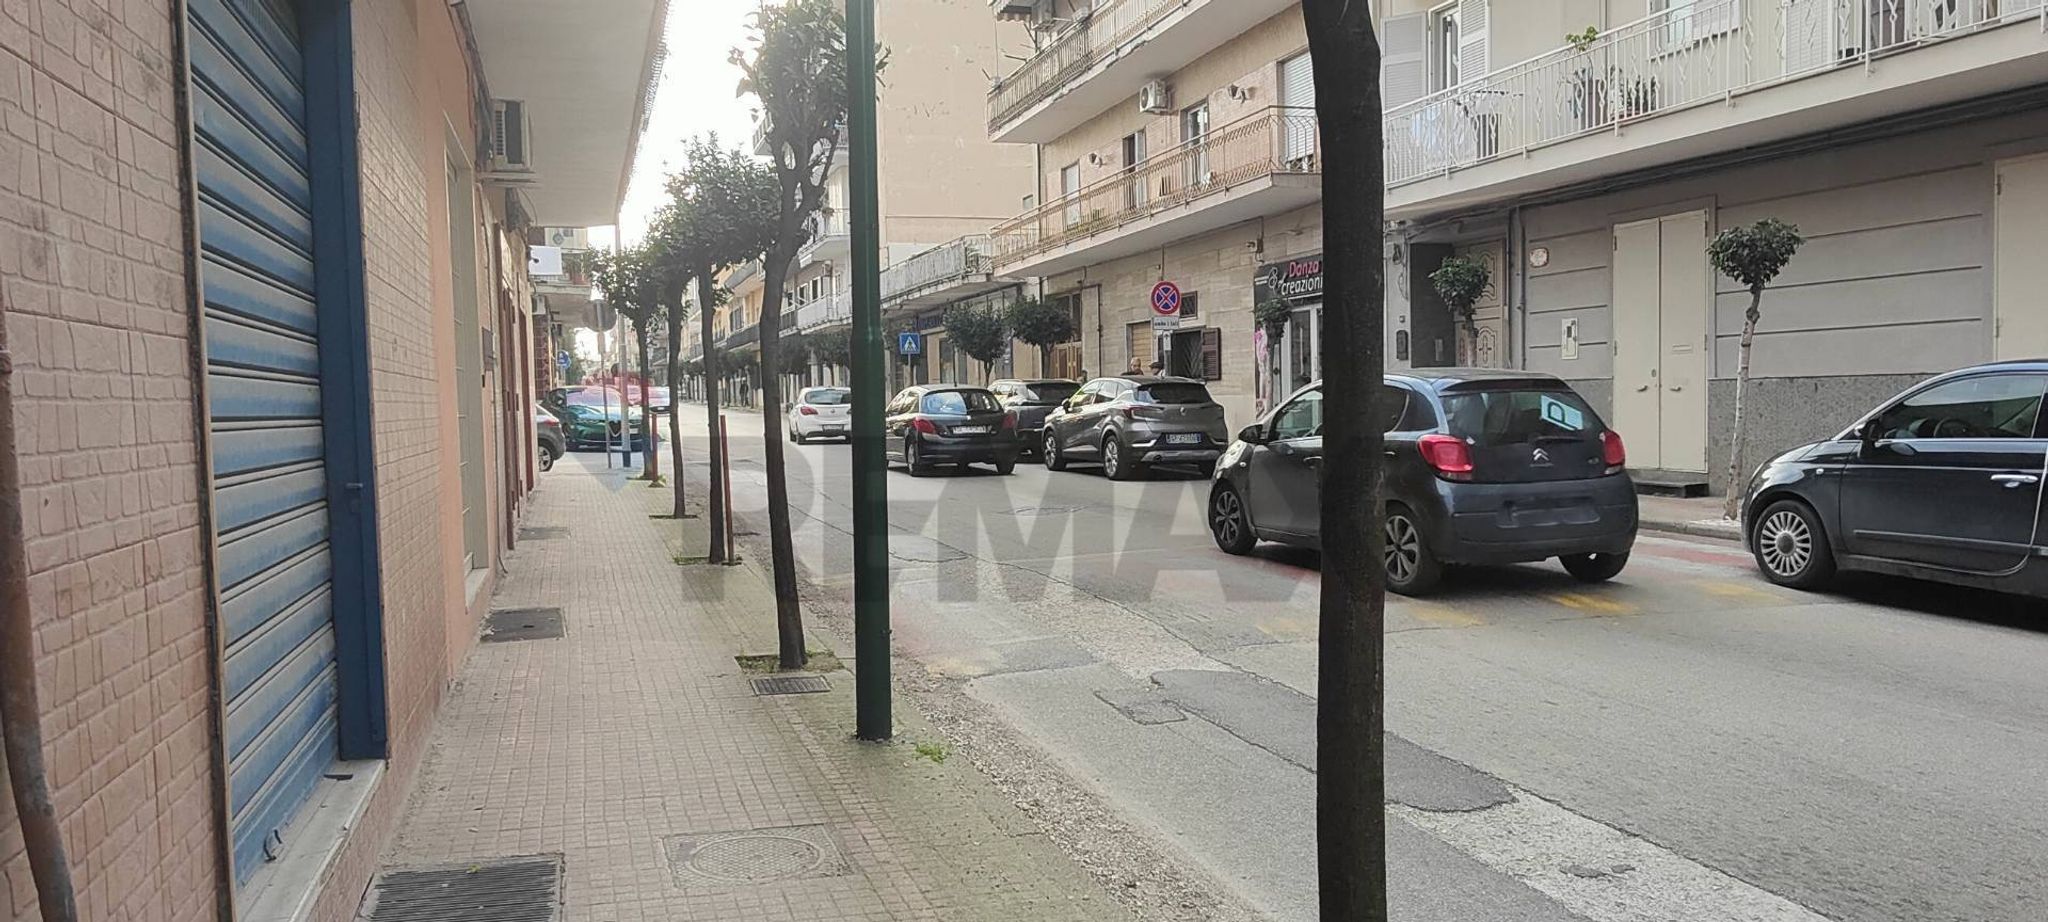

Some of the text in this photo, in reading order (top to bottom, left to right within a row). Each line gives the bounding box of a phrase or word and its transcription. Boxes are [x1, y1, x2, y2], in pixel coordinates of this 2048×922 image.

[1289, 261, 1319, 277] Danza
[1281, 272, 1323, 295] creazioni
[1547, 401, 1577, 429] P
